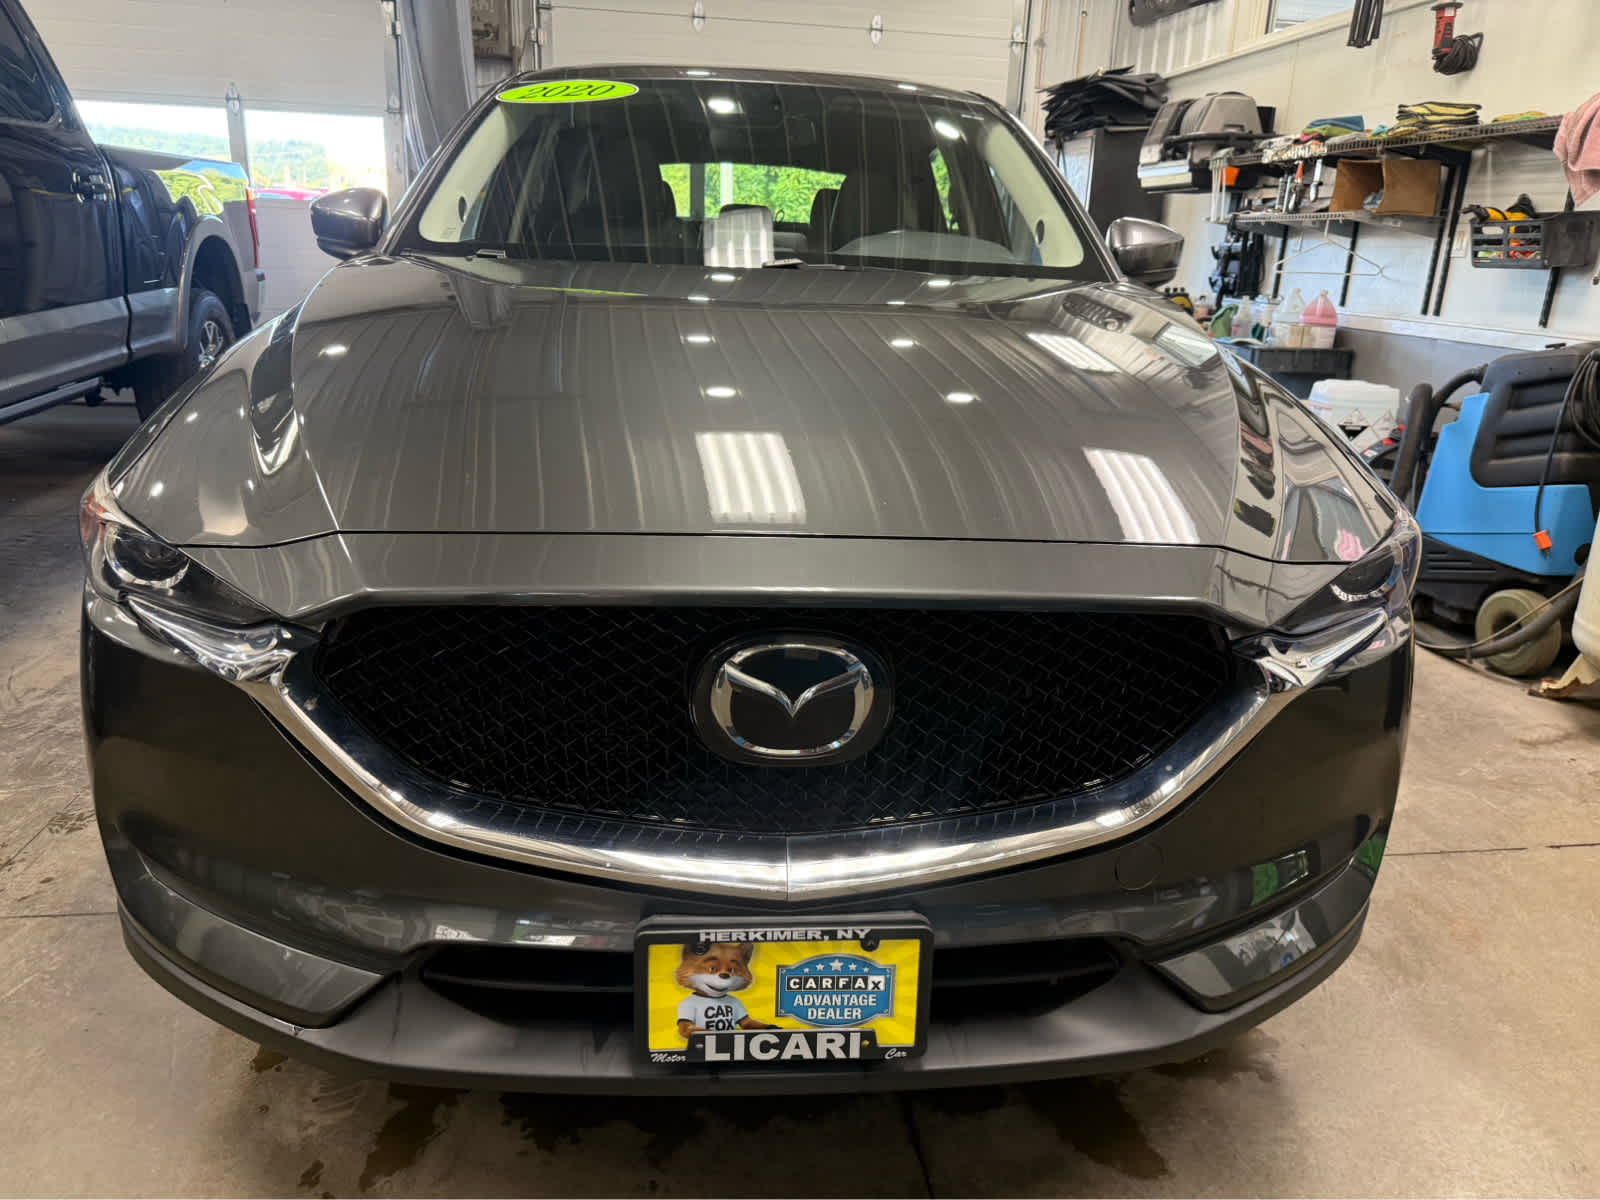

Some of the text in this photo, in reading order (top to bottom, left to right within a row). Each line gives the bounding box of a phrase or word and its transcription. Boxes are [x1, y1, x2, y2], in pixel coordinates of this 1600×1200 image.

[516, 84, 616, 99] 2020
[700, 928, 871, 942] HERKIMER, NY
[788, 977, 884, 991] CARFAX
[793, 994, 877, 1006] ADVANTAGE
[704, 1005, 734, 1019] CAR
[807, 1008, 862, 1020] DEALER
[705, 1019, 735, 1031] FOX
[704, 1032, 861, 1061] LICARI
[650, 1053, 687, 1063] Motor
[884, 1048, 908, 1060] Car
